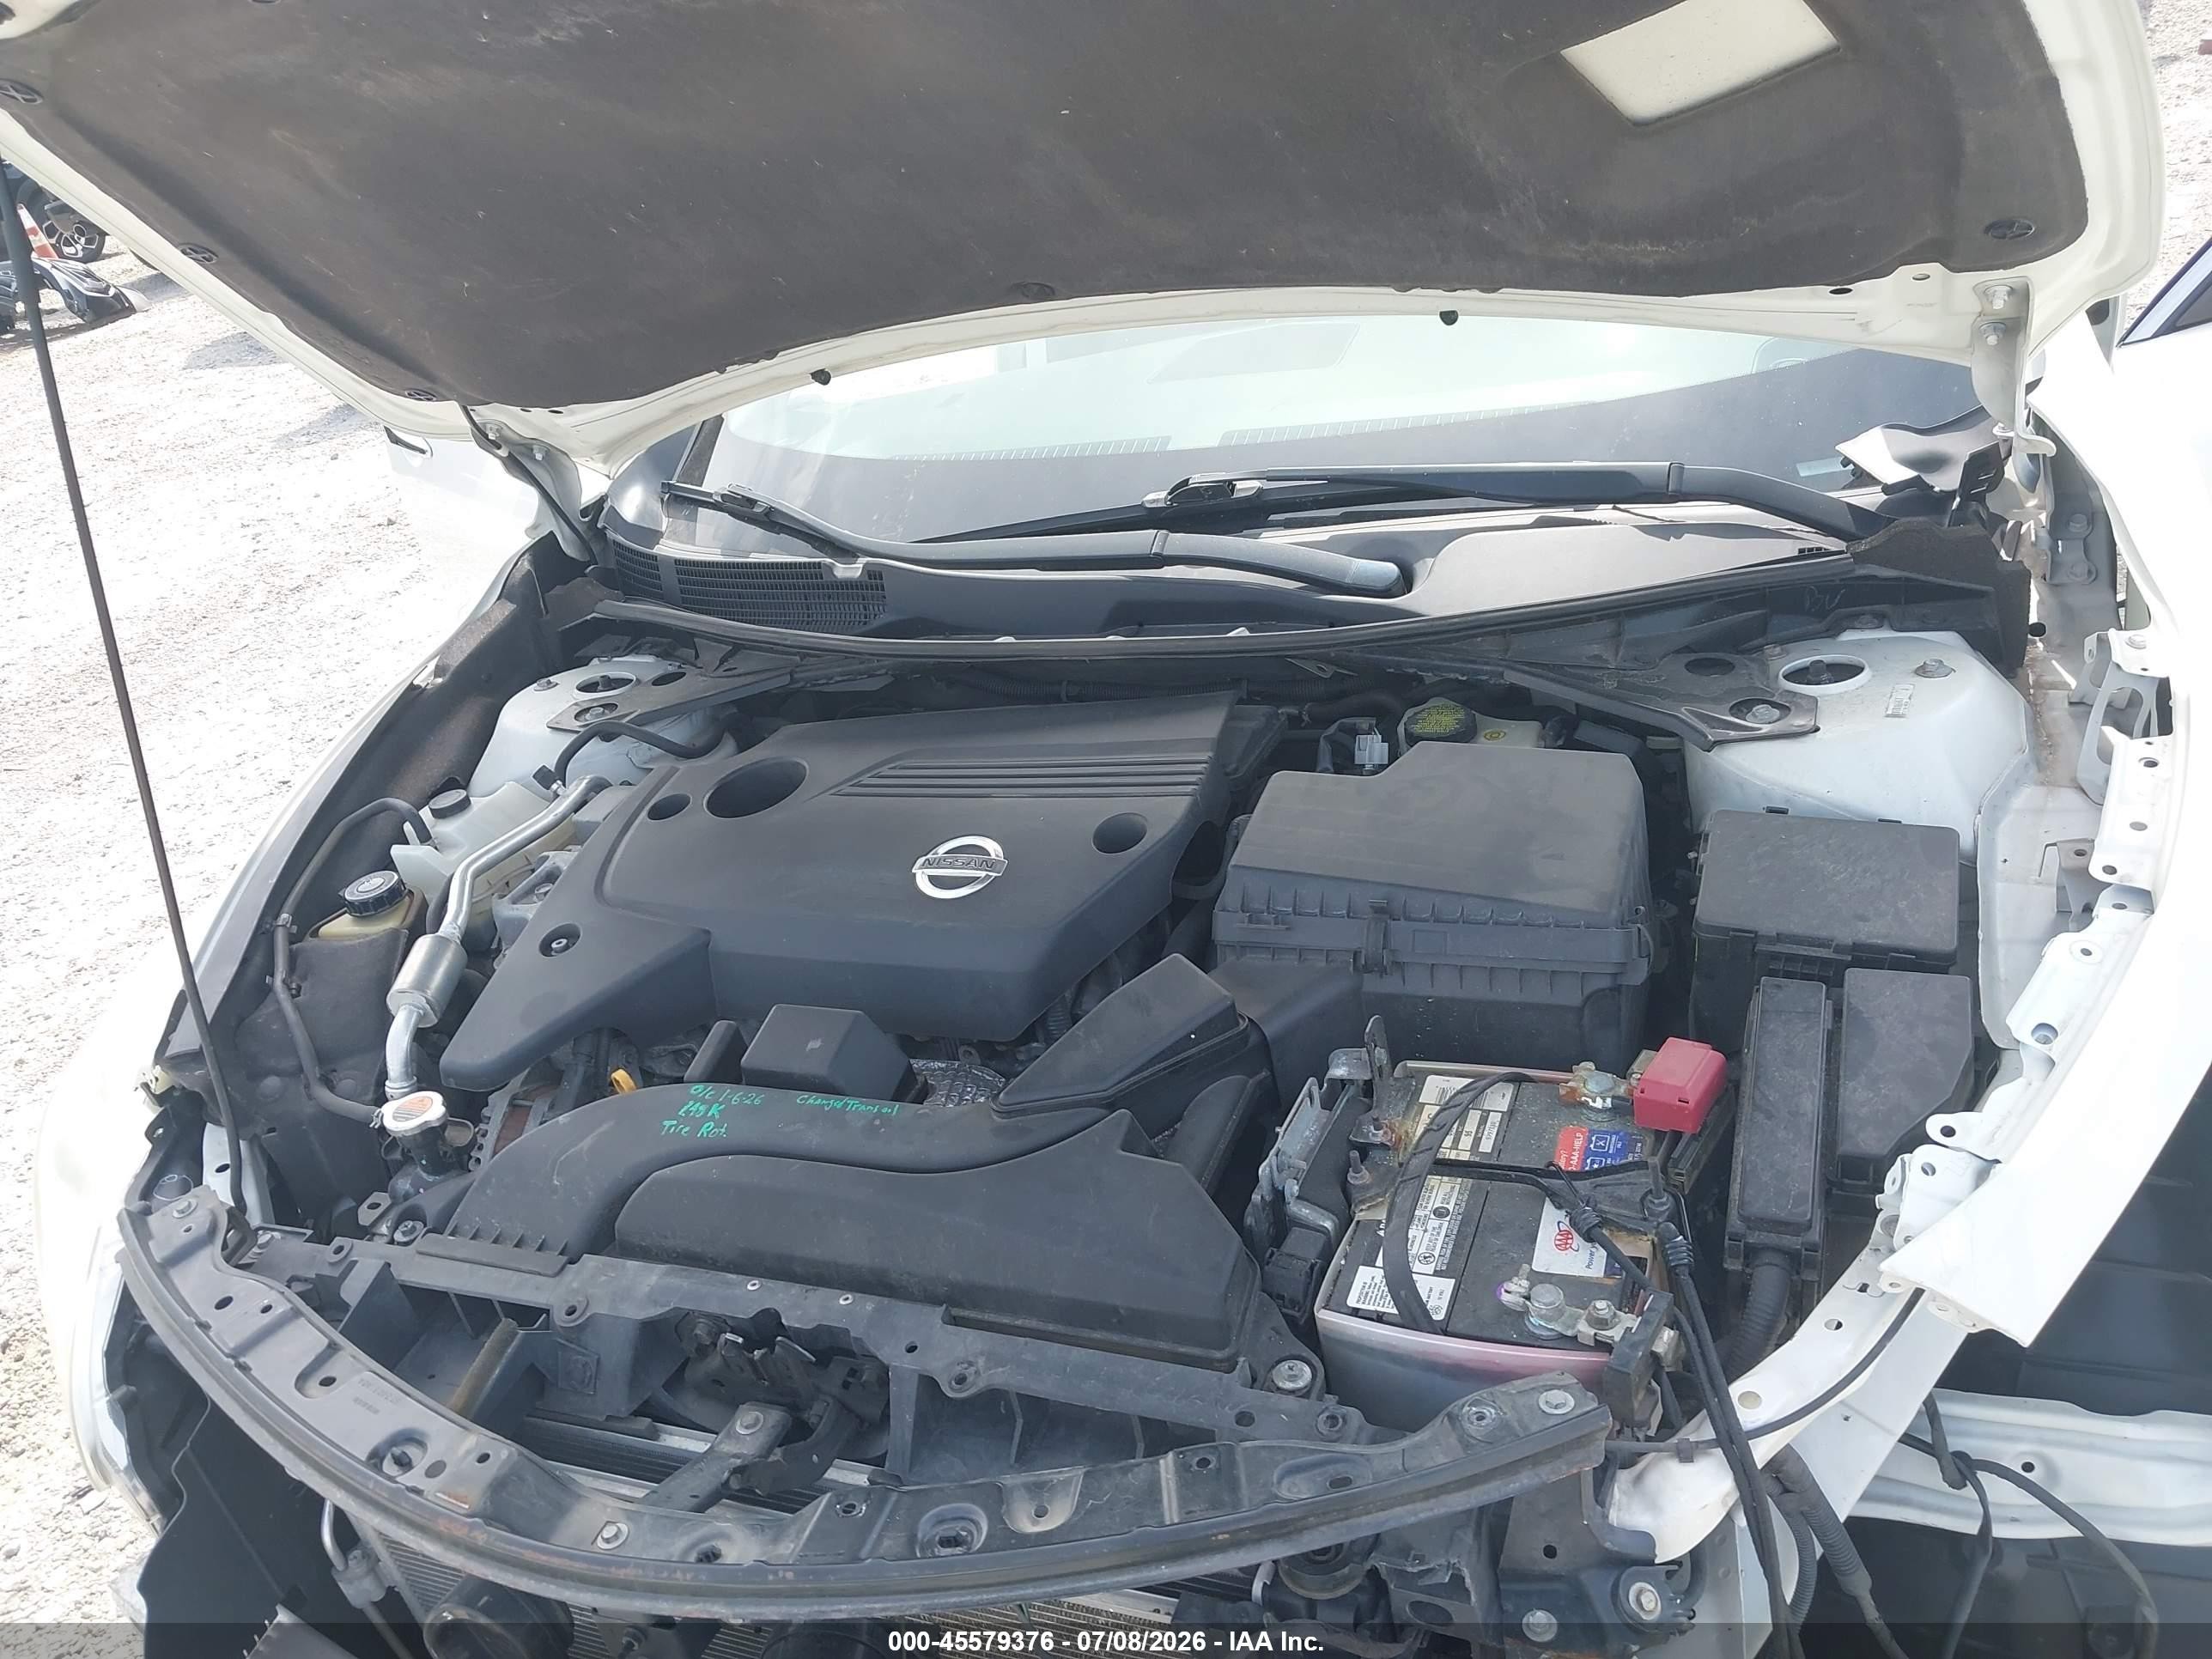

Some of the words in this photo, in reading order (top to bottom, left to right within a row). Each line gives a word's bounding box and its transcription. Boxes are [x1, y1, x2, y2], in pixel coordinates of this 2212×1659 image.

[921, 858, 995, 869] NISSAN
[660, 1121, 690, 1136] Tire
[1585, 1249, 1596, 1270] Power
